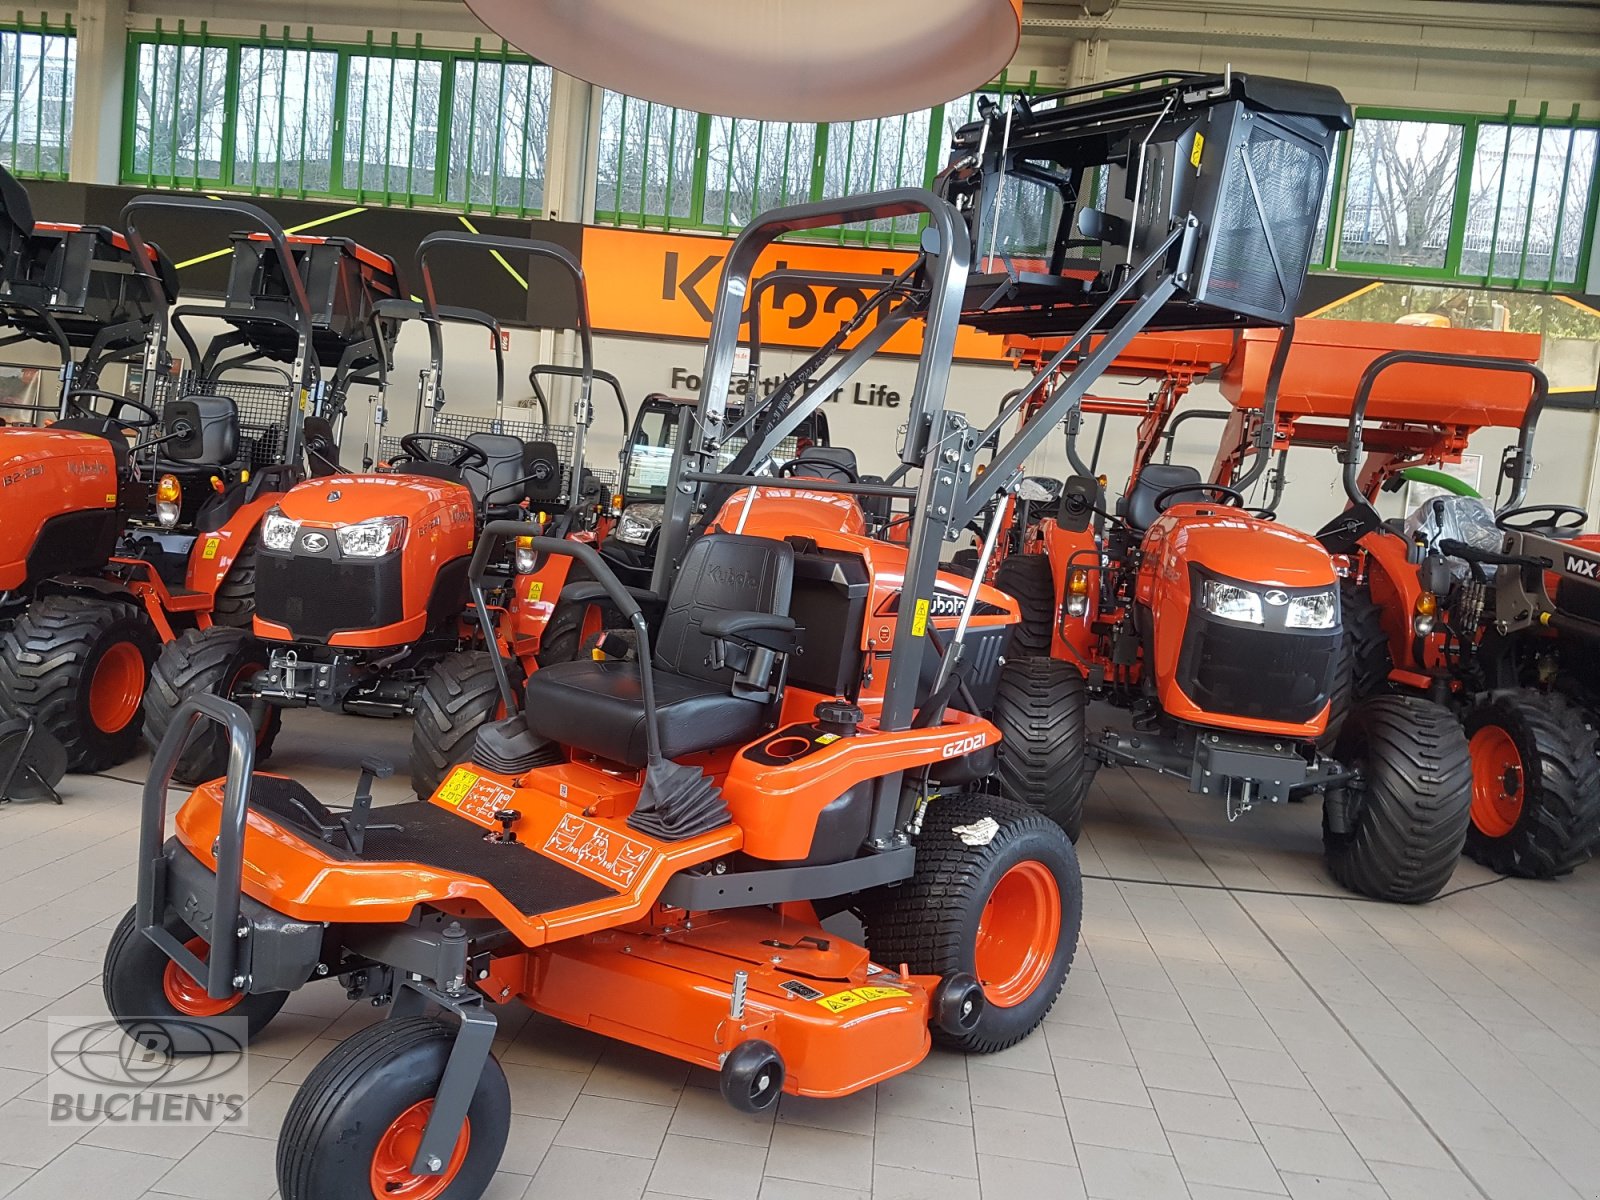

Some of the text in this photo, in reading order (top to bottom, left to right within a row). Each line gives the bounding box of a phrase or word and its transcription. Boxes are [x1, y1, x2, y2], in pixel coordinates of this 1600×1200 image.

[671, 367, 701, 391] Fo
[853, 382, 901, 408] Life
[1566, 555, 1598, 578] MX
[930, 595, 966, 614] ubota
